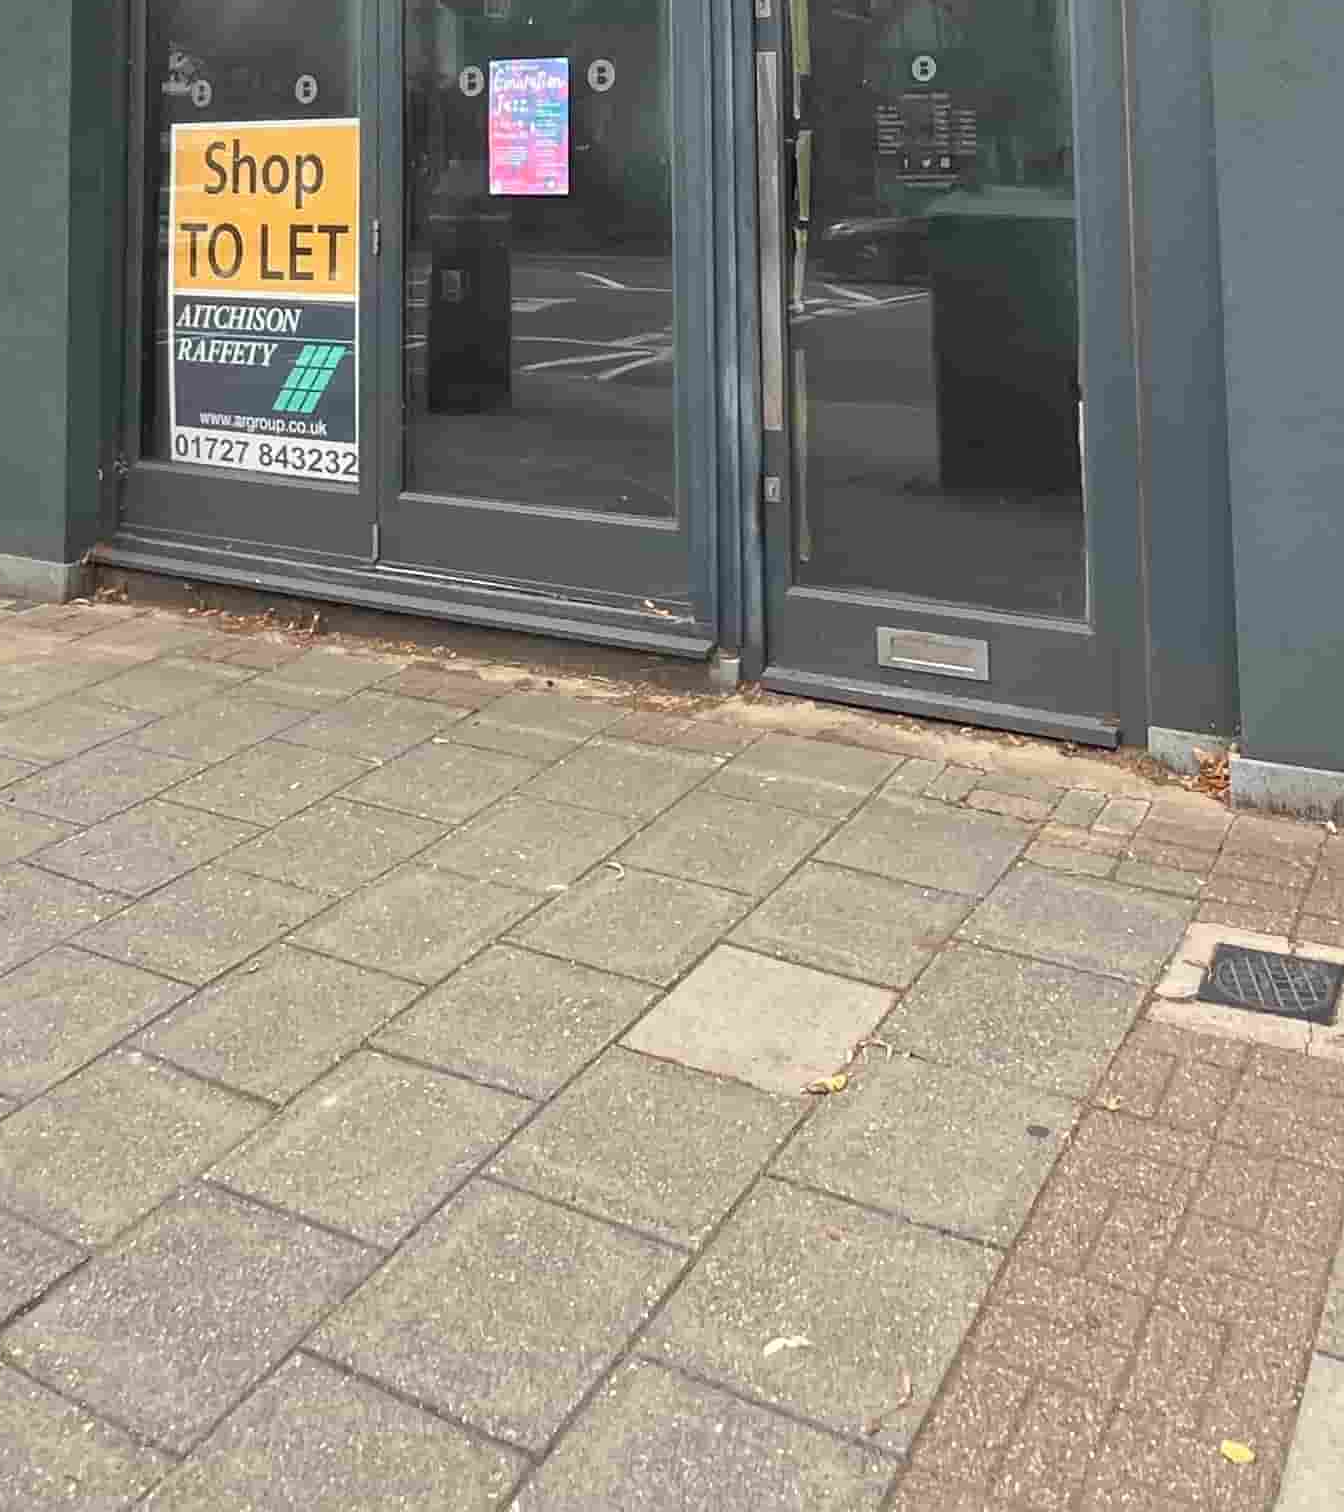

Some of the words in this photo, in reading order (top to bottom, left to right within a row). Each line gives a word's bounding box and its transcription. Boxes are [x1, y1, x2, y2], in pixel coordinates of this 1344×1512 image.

[203, 138, 325, 210] Shop
[178, 222, 243, 279] TO
[260, 223, 349, 281] LET
[175, 304, 303, 334] AITCHISON
[176, 338, 279, 367] RAFFETY
[199, 412, 328, 437] www.argroup.co.uk
[175, 433, 249, 465] 01727
[258, 443, 359, 476] 843232
